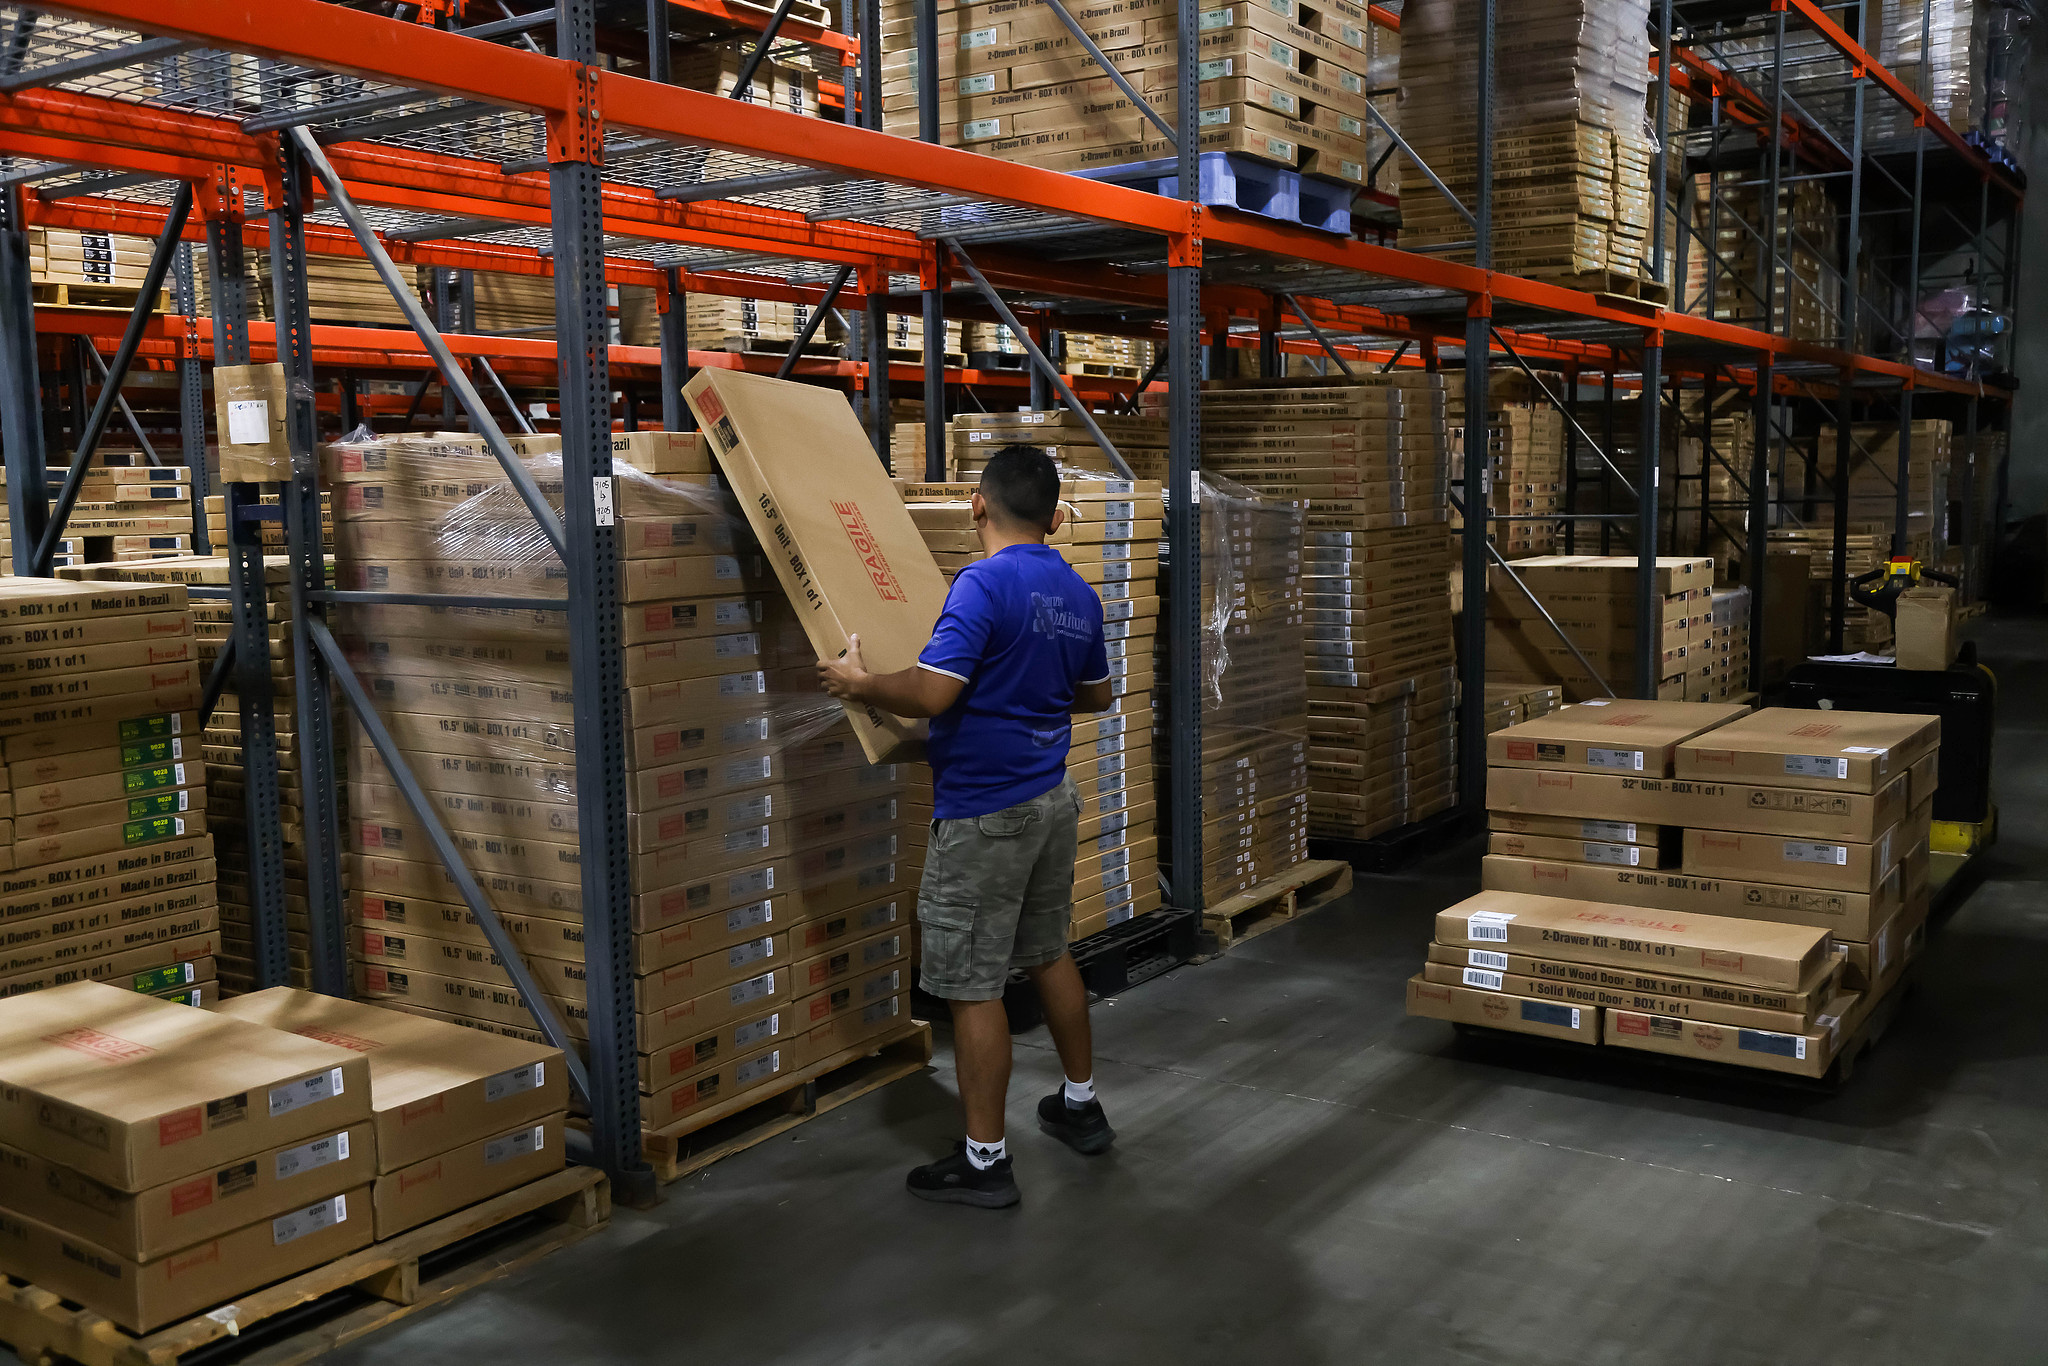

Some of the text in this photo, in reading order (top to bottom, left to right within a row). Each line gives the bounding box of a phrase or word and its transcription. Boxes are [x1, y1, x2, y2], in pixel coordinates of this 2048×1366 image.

[988, 48, 1017, 60] 2-Drawer
[1019, 45, 1028, 54] Kit
[1035, 41, 1049, 51] BOX
[1056, 38, 1063, 48] of
[1203, 33, 1233, 46] in Brazil
[992, 93, 1021, 105] 2-Drawer
[1023, 90, 1032, 100] Kit
[1039, 88, 1053, 97] BOX
[1060, 86, 1068, 94] of
[991, 139, 1019, 151] 2-Drawer
[1021, 136, 1030, 146] Kit
[1037, 133, 1049, 142] BOX
[1057, 132, 1065, 140] of
[594, 481, 609, 490] 9105
[758, 492, 778, 519] 16.5"
[774, 524, 791, 548] Unit
[790, 555, 807, 581] BOX
[802, 578, 811, 588] 1
[807, 588, 819, 604] of
[814, 600, 822, 610] 1
[838, 501, 897, 602] FRAGILE
[20, 604, 43, 616] BOX
[49, 603, 53, 614] 1
[58, 602, 69, 613] of
[74, 602, 78, 611] 1
[92, 598, 122, 610] Made
[125, 596, 135, 607] in
[139, 593, 169, 606] Brazil
[25, 630, 50, 642] BOX
[53, 629, 58, 640] 1
[62, 628, 74, 640] of
[79, 627, 83, 637] 1
[440, 720, 460, 731] 16.5"
[463, 721, 480, 733] Unit
[487, 723, 503, 735] BOX
[506, 726, 509, 736] 1
[513, 726, 521, 736] of
[523, 727, 527, 737] 1
[1622, 779, 1638, 789] 32"
[1642, 780, 1661, 791] Unit
[1672, 781, 1692, 793] BOX
[1697, 784, 1700, 794] 1
[1705, 785, 1717, 795] of
[1720, 786, 1724, 795] 1
[3, 879, 36, 892] Doors
[49, 870, 71, 884] BOX
[76, 869, 80, 879] 1
[86, 867, 97, 877] of
[101, 864, 105, 874] 1
[118, 859, 147, 871] Made
[151, 853, 160, 864] in
[164, 847, 193, 861] Brazil
[8, 928, 41, 944] Doors
[52, 920, 75, 934] BOX
[80, 918, 84, 929] 1
[89, 916, 100, 927] of
[105, 914, 108, 924] 1
[122, 906, 151, 920] Made
[154, 901, 164, 912] in
[168, 895, 197, 910] Brazil
[1576, 912, 1686, 930] FRAGILE
[1542, 930, 1590, 946] 2-Drawer
[1593, 935, 1608, 948] Kit
[1620, 940, 1641, 952] BOX
[1646, 943, 1650, 953] 1
[1655, 945, 1666, 956] of
[1670, 947, 1674, 956] 1
[445, 983, 464, 995] 16.5"
[469, 987, 484, 999] Unit
[493, 994, 509, 1005] BOX
[511, 996, 515, 1006] 1
[1531, 963, 1535, 972] 1
[1540, 964, 1565, 977] Solid
[1569, 968, 1597, 981] Wood
[1601, 972, 1625, 985] Door
[1636, 977, 1657, 990] BOX
[1662, 982, 1666, 991] 1
[1671, 983, 1683, 994] of
[1687, 985, 1690, 994] 1
[1702, 987, 1735, 1001] Made
[1739, 991, 1749, 1003] in
[1753, 994, 1786, 1008] Brazil
[1529, 982, 1533, 992] 1
[1538, 983, 1563, 997] Solid
[1567, 987, 1595, 1001] Wood
[1598, 992, 1623, 1005] Door
[1634, 997, 1655, 1010] BOX
[1659, 1001, 1664, 1010] 1
[1669, 1003, 1681, 1013] of
[1685, 1005, 1689, 1014] 1
[305, 1077, 323, 1088] 9205
[311, 1141, 329, 1152] 9205
[309, 1204, 326, 1216] 9205
